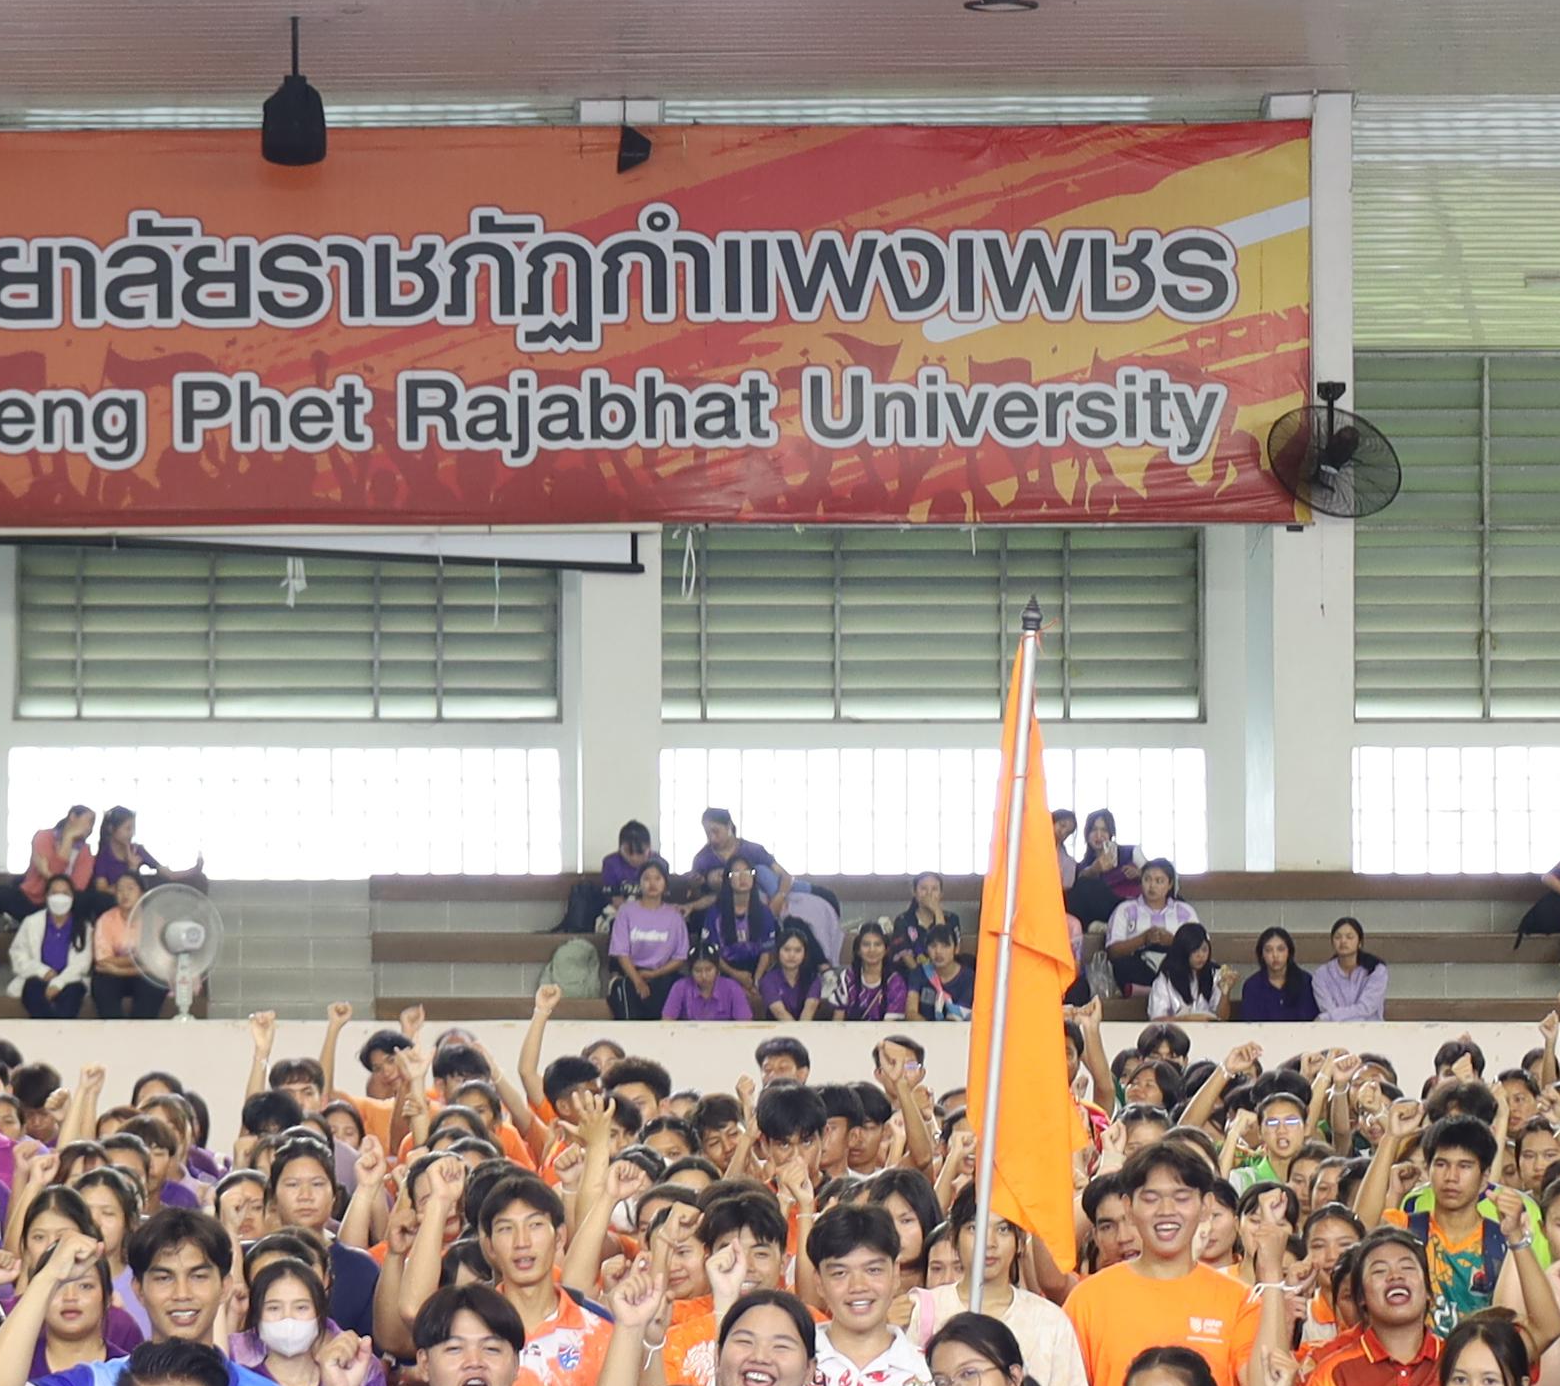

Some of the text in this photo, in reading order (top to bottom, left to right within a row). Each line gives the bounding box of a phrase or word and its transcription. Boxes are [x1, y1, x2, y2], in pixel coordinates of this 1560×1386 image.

[178, 379, 366, 446] Phet
[403, 375, 771, 461] Rajabhat
[808, 373, 1220, 458] University
